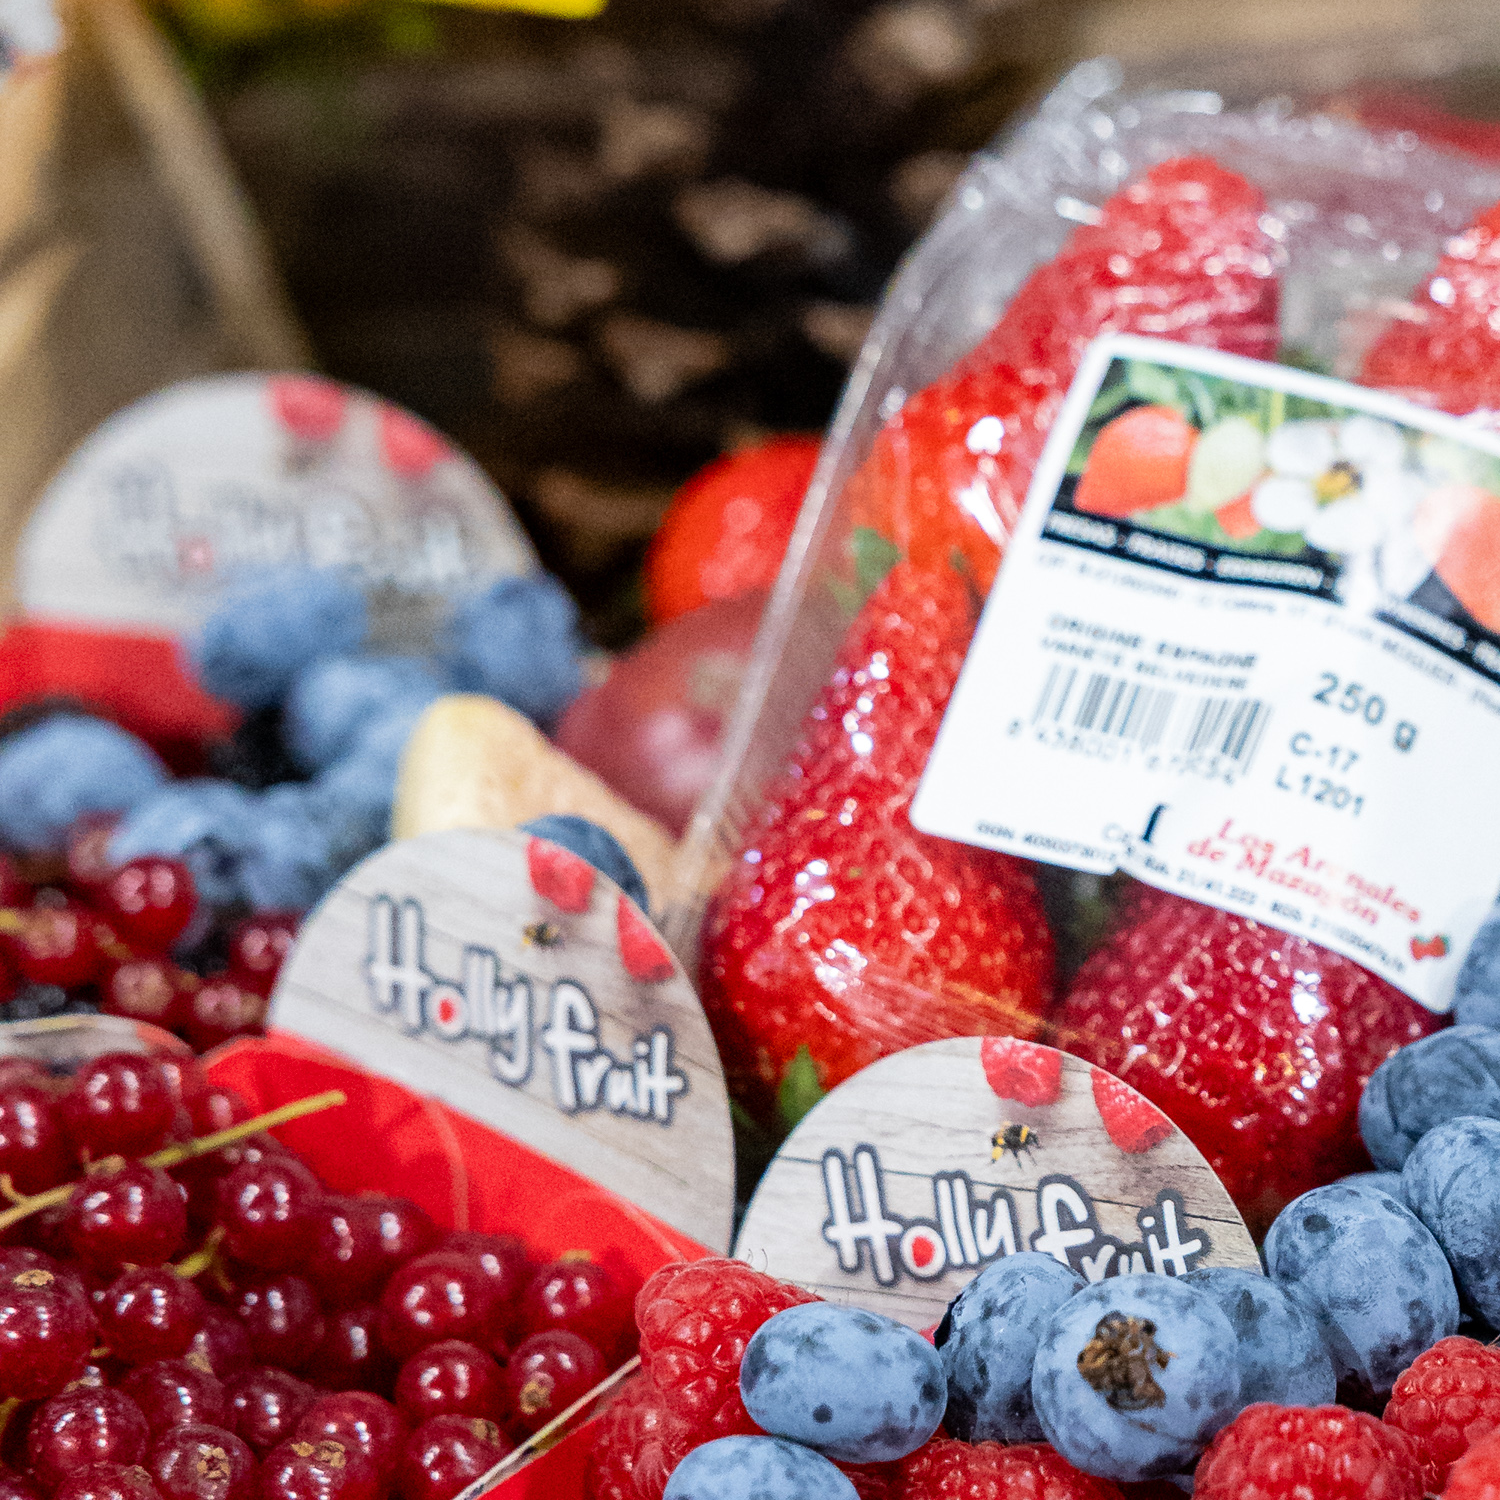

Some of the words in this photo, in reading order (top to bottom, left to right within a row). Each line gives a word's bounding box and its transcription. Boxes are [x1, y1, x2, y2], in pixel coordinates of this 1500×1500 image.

[1288, 730, 1360, 774] C-17
[1312, 670, 1387, 727] 250
[1393, 719, 1418, 752] g
[1285, 845, 1420, 923] Arnales
[362, 892, 534, 1089] Holly
[542, 976, 691, 1128] fruit
[822, 1143, 1025, 1286] Holly
[1031, 1174, 1213, 1286] fruit
